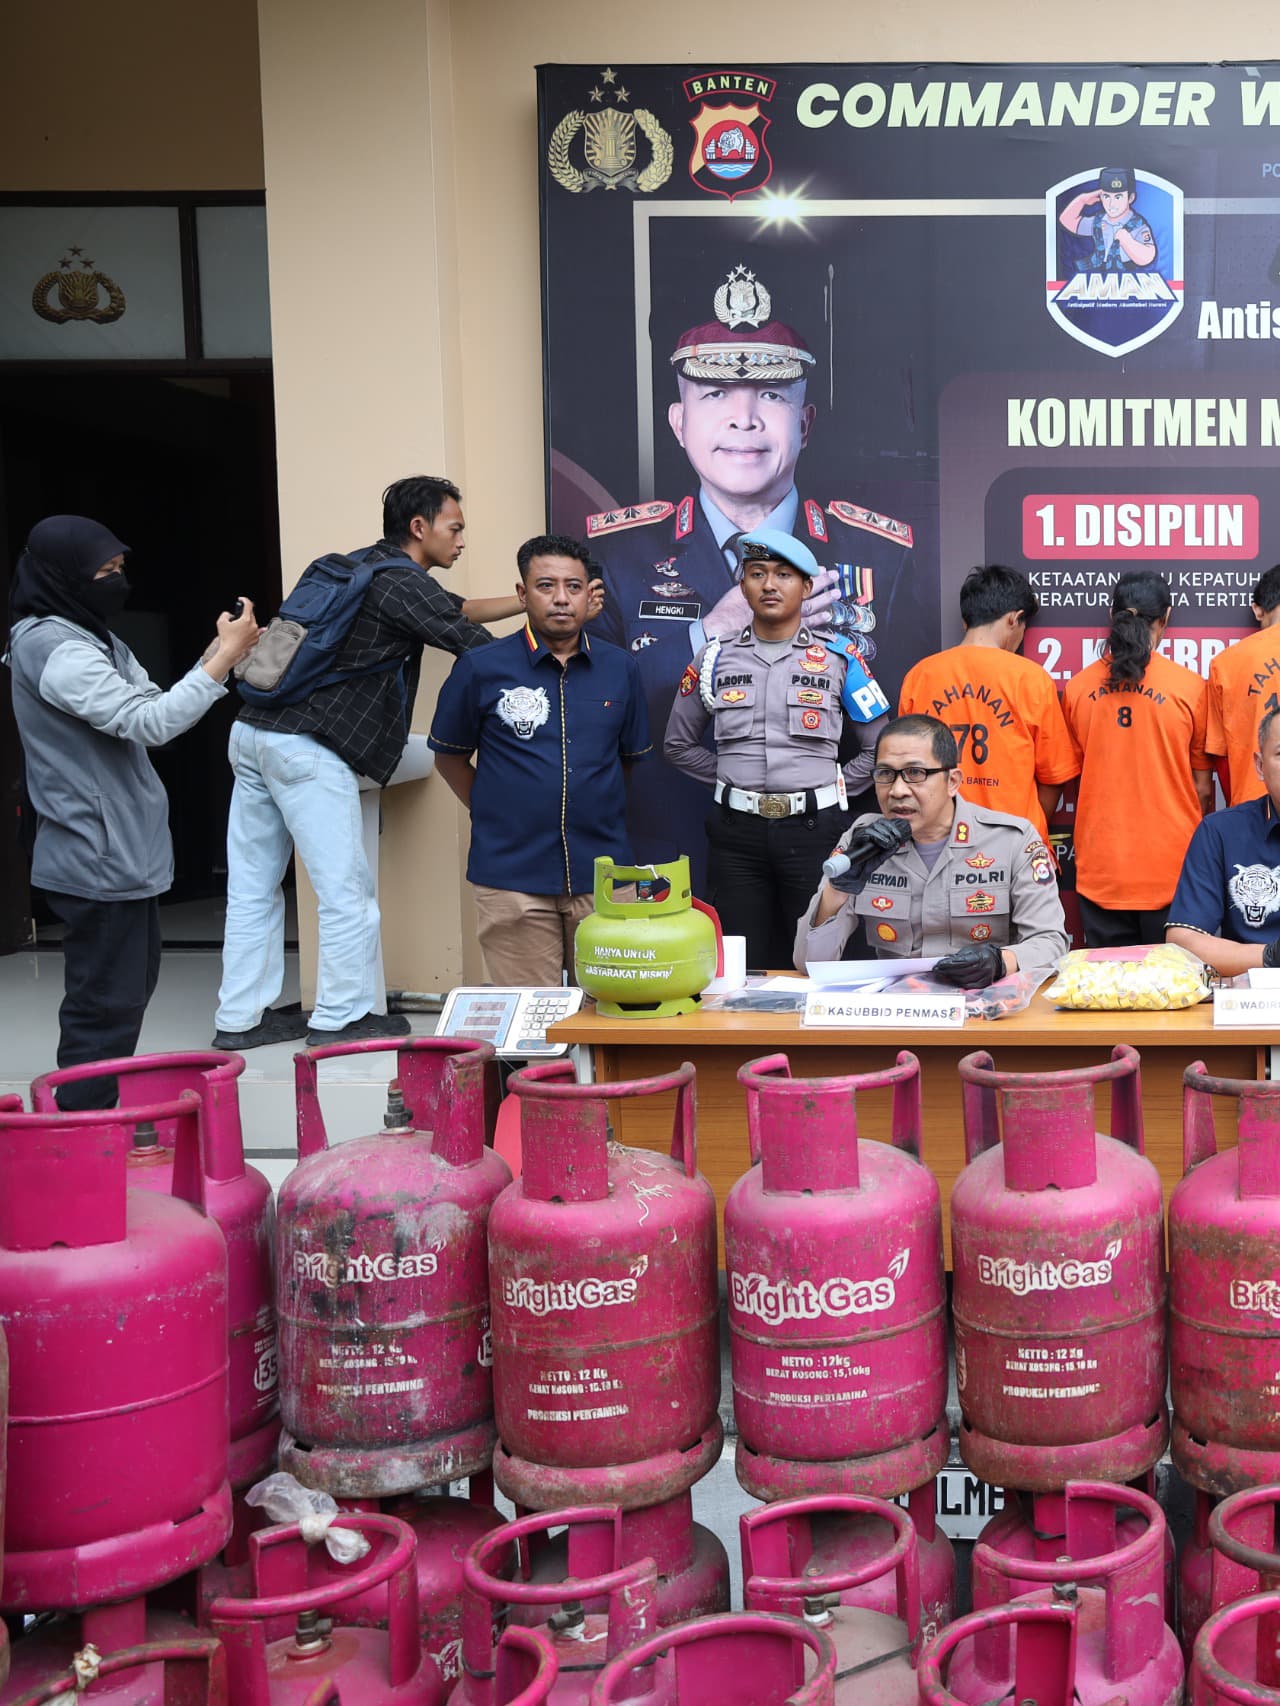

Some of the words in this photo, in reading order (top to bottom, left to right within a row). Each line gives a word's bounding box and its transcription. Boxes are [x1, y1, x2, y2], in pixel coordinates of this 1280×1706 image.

[692, 75, 769, 95] BANTEN
[797, 81, 1215, 128] COMMANDER
[1055, 273, 1176, 300] AMAN
[1007, 398, 1247, 447] KOMITMEN
[1035, 504, 1065, 547] 1.
[1075, 504, 1243, 547] DISIPLIN
[1028, 573, 1120, 586] KETAATAN
[1179, 573, 1260, 586] KEPATUH
[1035, 593, 1114, 606] ERATUR
[655, 605, 685, 616] HENGKI
[792, 675, 830, 689] POLRI
[1088, 682, 1166, 705] TAHANAN
[924, 683, 1014, 728] AHANAN
[1117, 706, 1133, 728] 8
[954, 870, 1005, 885] POLRI
[594, 946, 622, 959] HANYA
[827, 1006, 891, 1018] KASUBBID
[896, 1007, 950, 1019] PENMAS
[1018, 1348, 1048, 1359] NETTO
[1056, 1349, 1067, 1359] 12
[781, 1356, 813, 1367] NETTO
[769, 1392, 811, 1403] PRODUKSI
